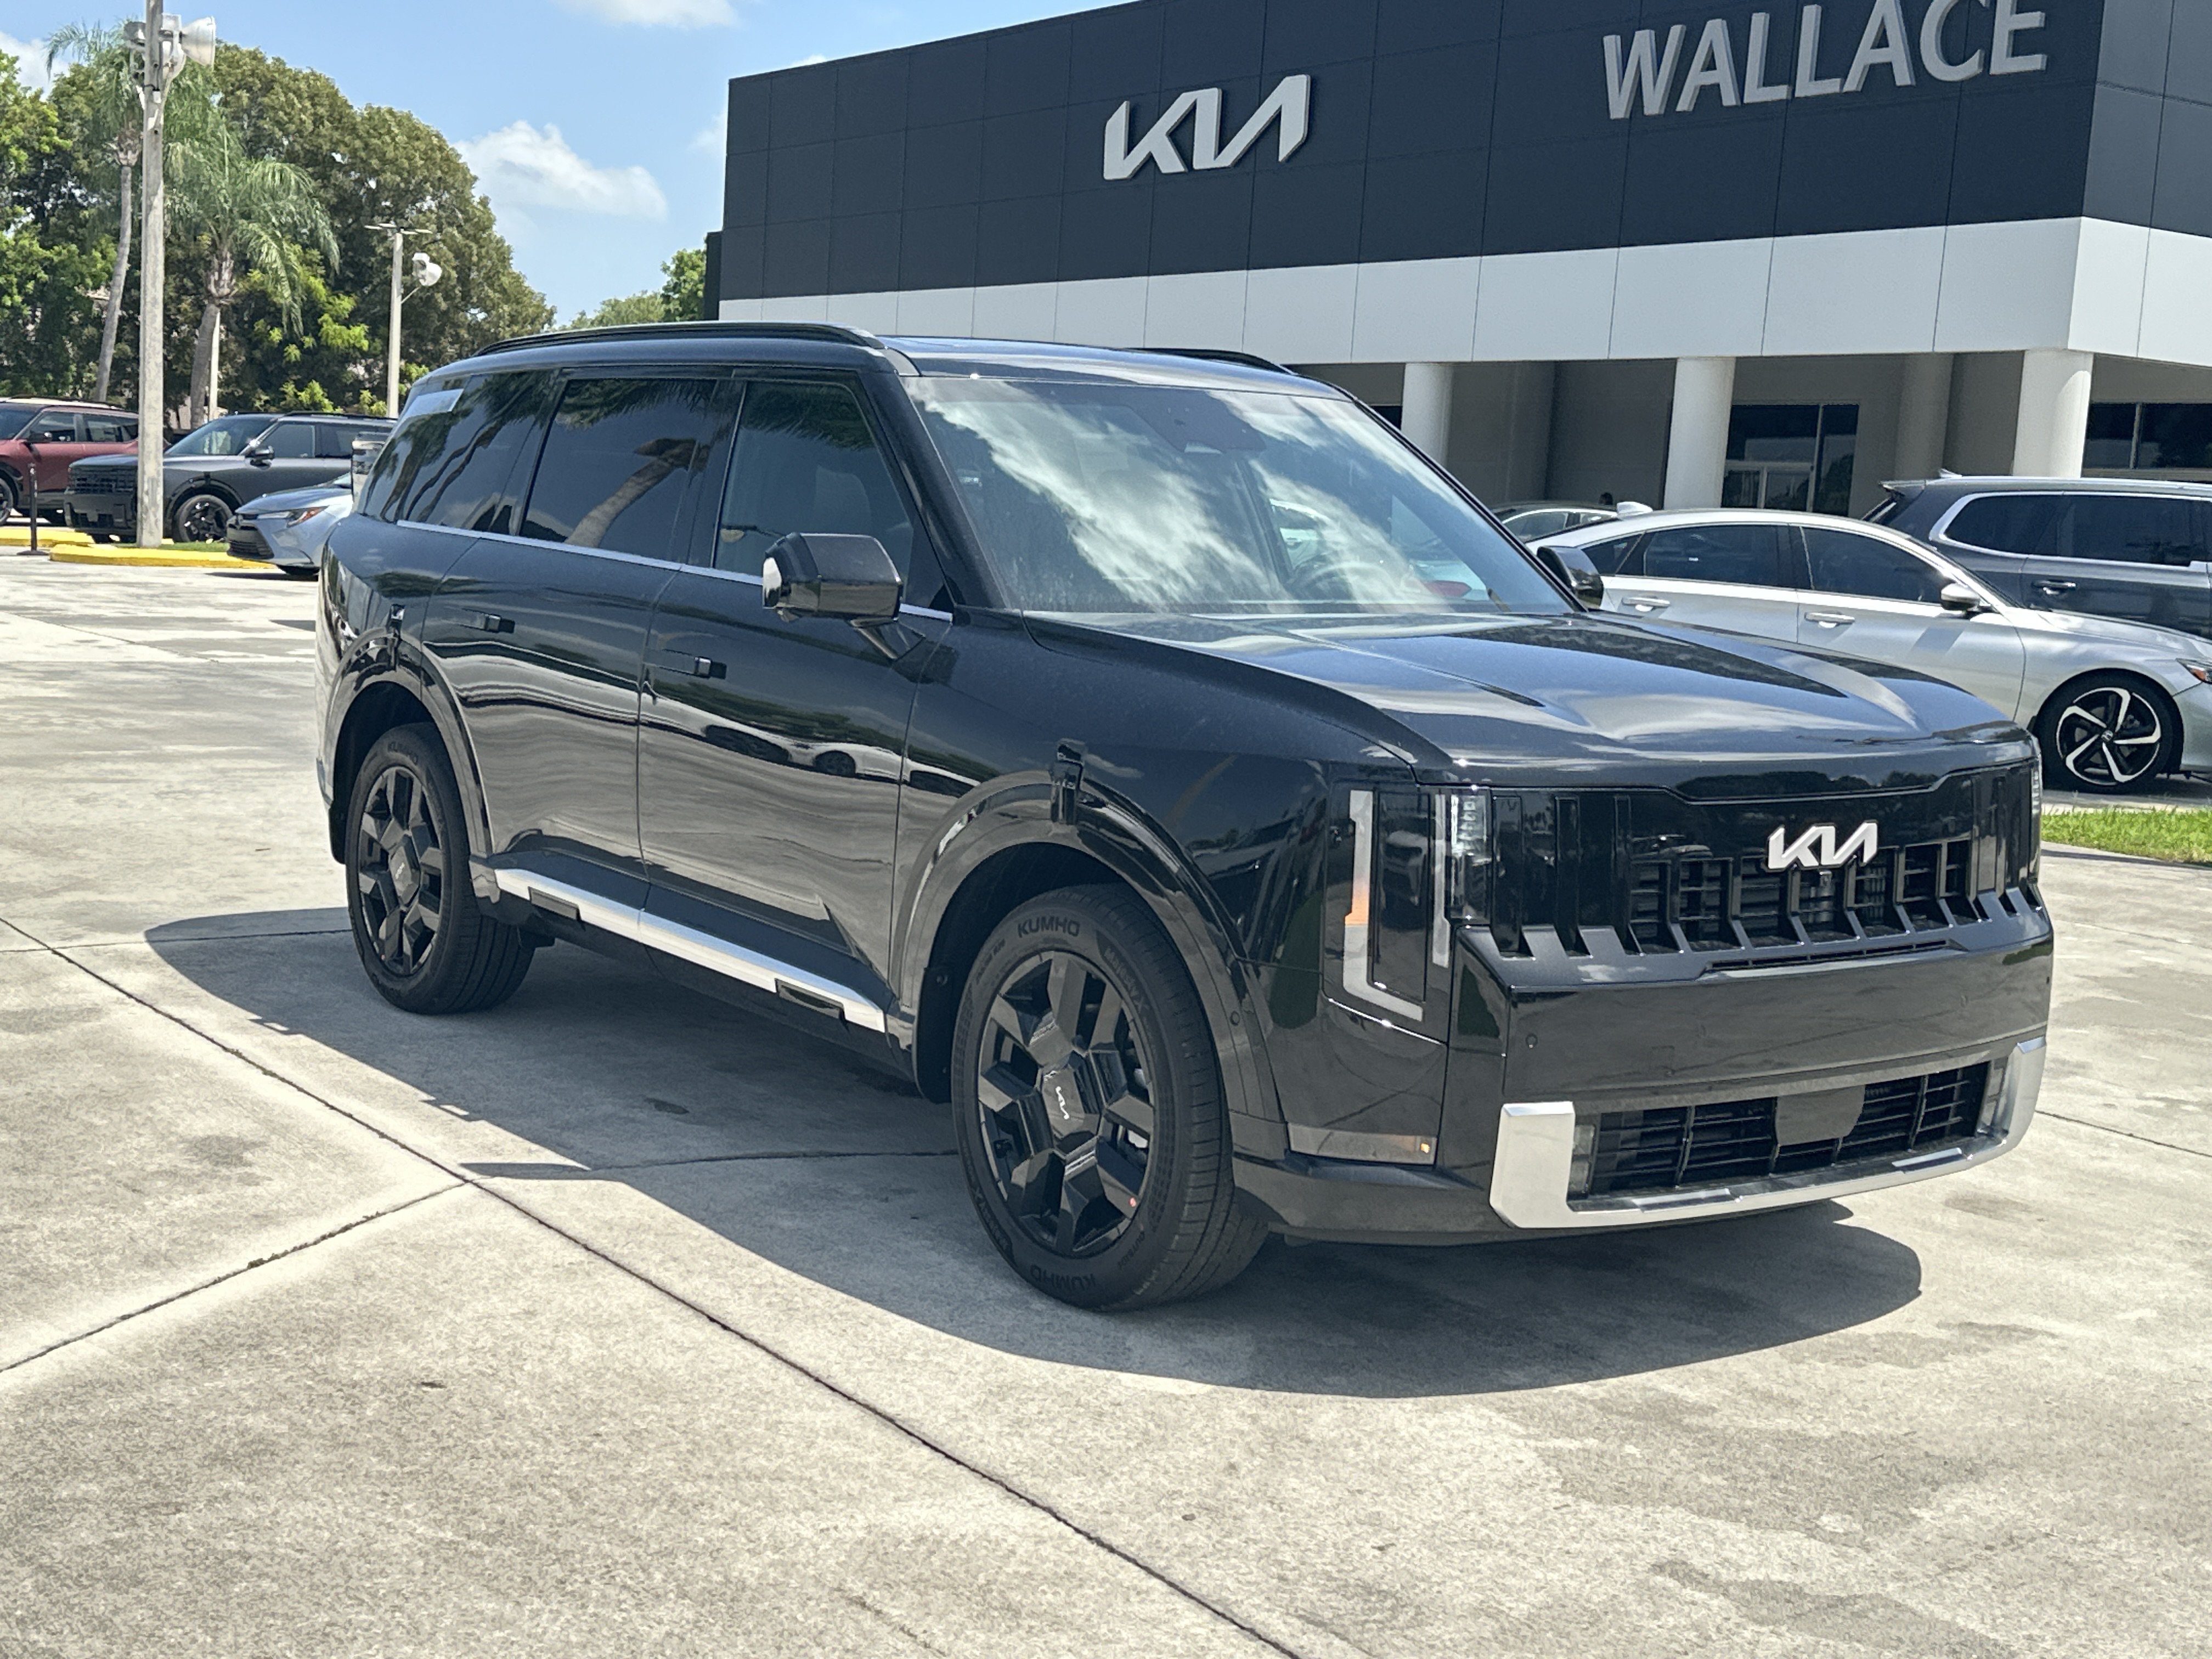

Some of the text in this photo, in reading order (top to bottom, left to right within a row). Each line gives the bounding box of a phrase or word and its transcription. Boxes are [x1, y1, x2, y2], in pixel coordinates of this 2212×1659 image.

[1602, 0, 2047, 120] WALLACE
[1103, 74, 1311, 180] KIA
[1768, 822, 1878, 870] KIA
[1018, 916, 1080, 938] KUMHO
[1030, 1263, 1096, 1291] KUMHO
